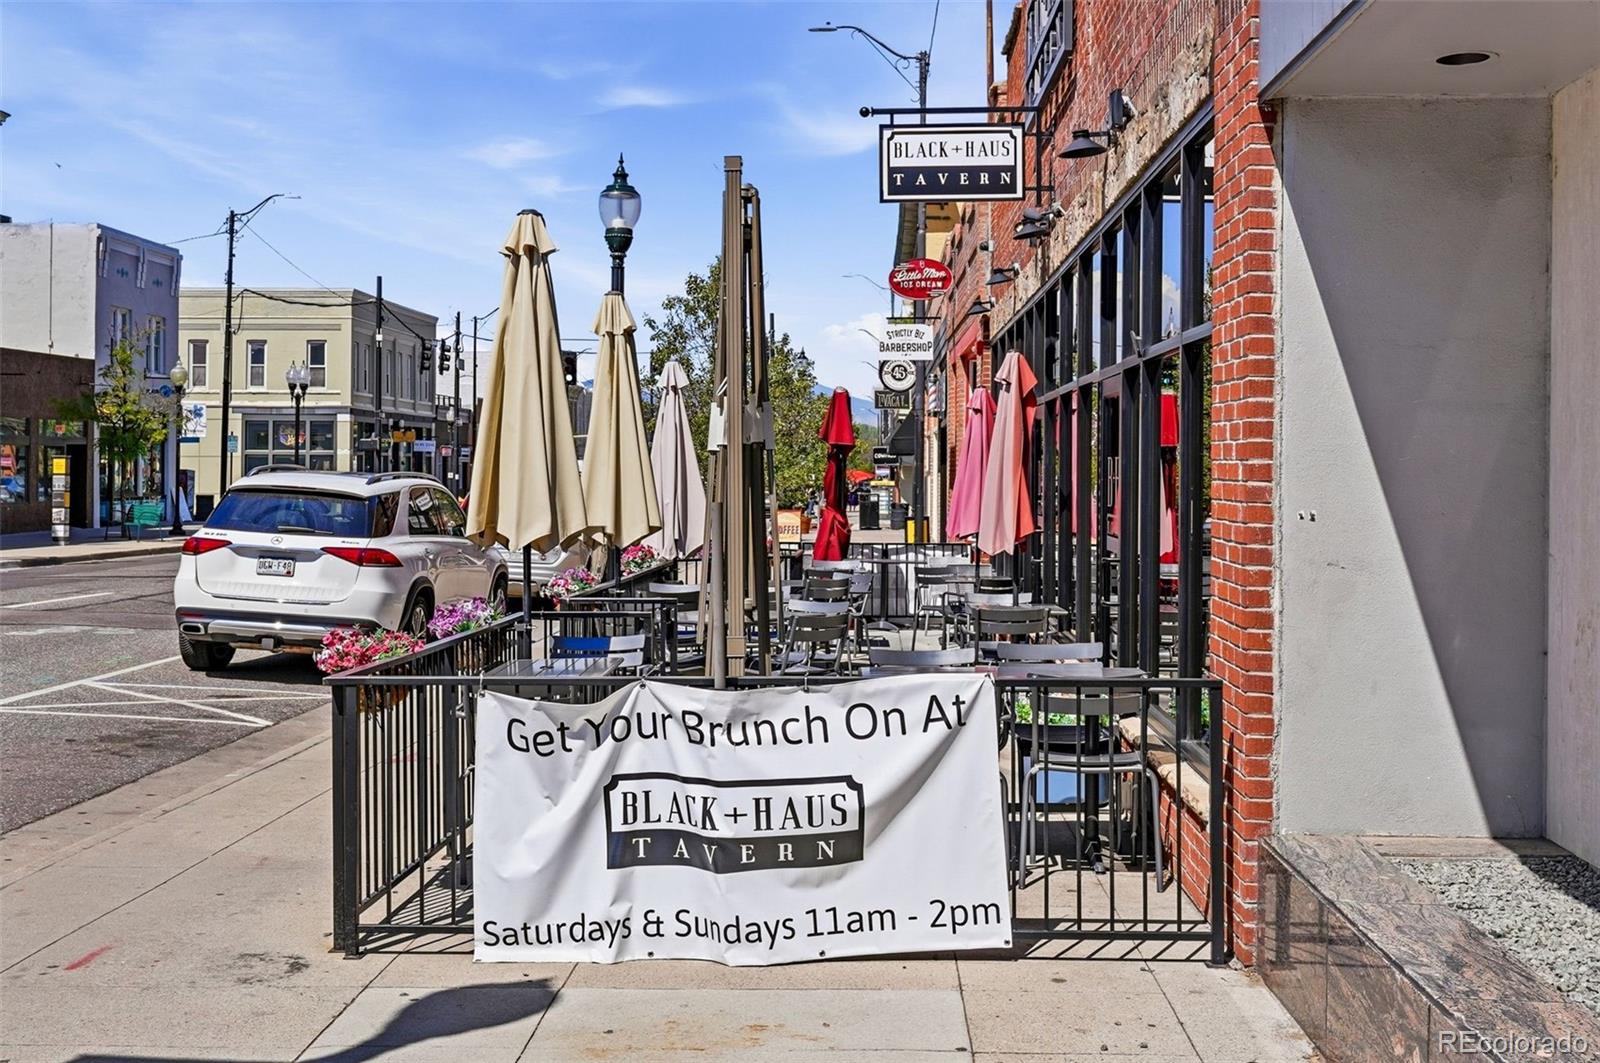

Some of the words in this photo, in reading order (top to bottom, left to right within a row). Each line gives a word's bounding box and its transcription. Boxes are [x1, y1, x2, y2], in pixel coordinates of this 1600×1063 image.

[893, 172, 1011, 186] TAVERN
[915, 280, 943, 288] CREAM
[886, 328, 914, 340] STRICTLY
[914, 328, 925, 340] BIZ
[879, 341, 933, 353] BARBERSHOP
[778, 524, 800, 535] OFFEE
[507, 717, 571, 756] Get
[585, 711, 672, 747] Your
[681, 704, 829, 747] Brunch
[845, 702, 908, 740] On
[922, 694, 967, 733] At
[631, 836, 836, 864] TAVERN
[482, 912, 632, 949] Saturdays
[642, 909, 665, 938] &
[674, 909, 796, 950] Sundays
[805, 906, 896, 938] 11am
[929, 899, 1001, 935] 2pm
